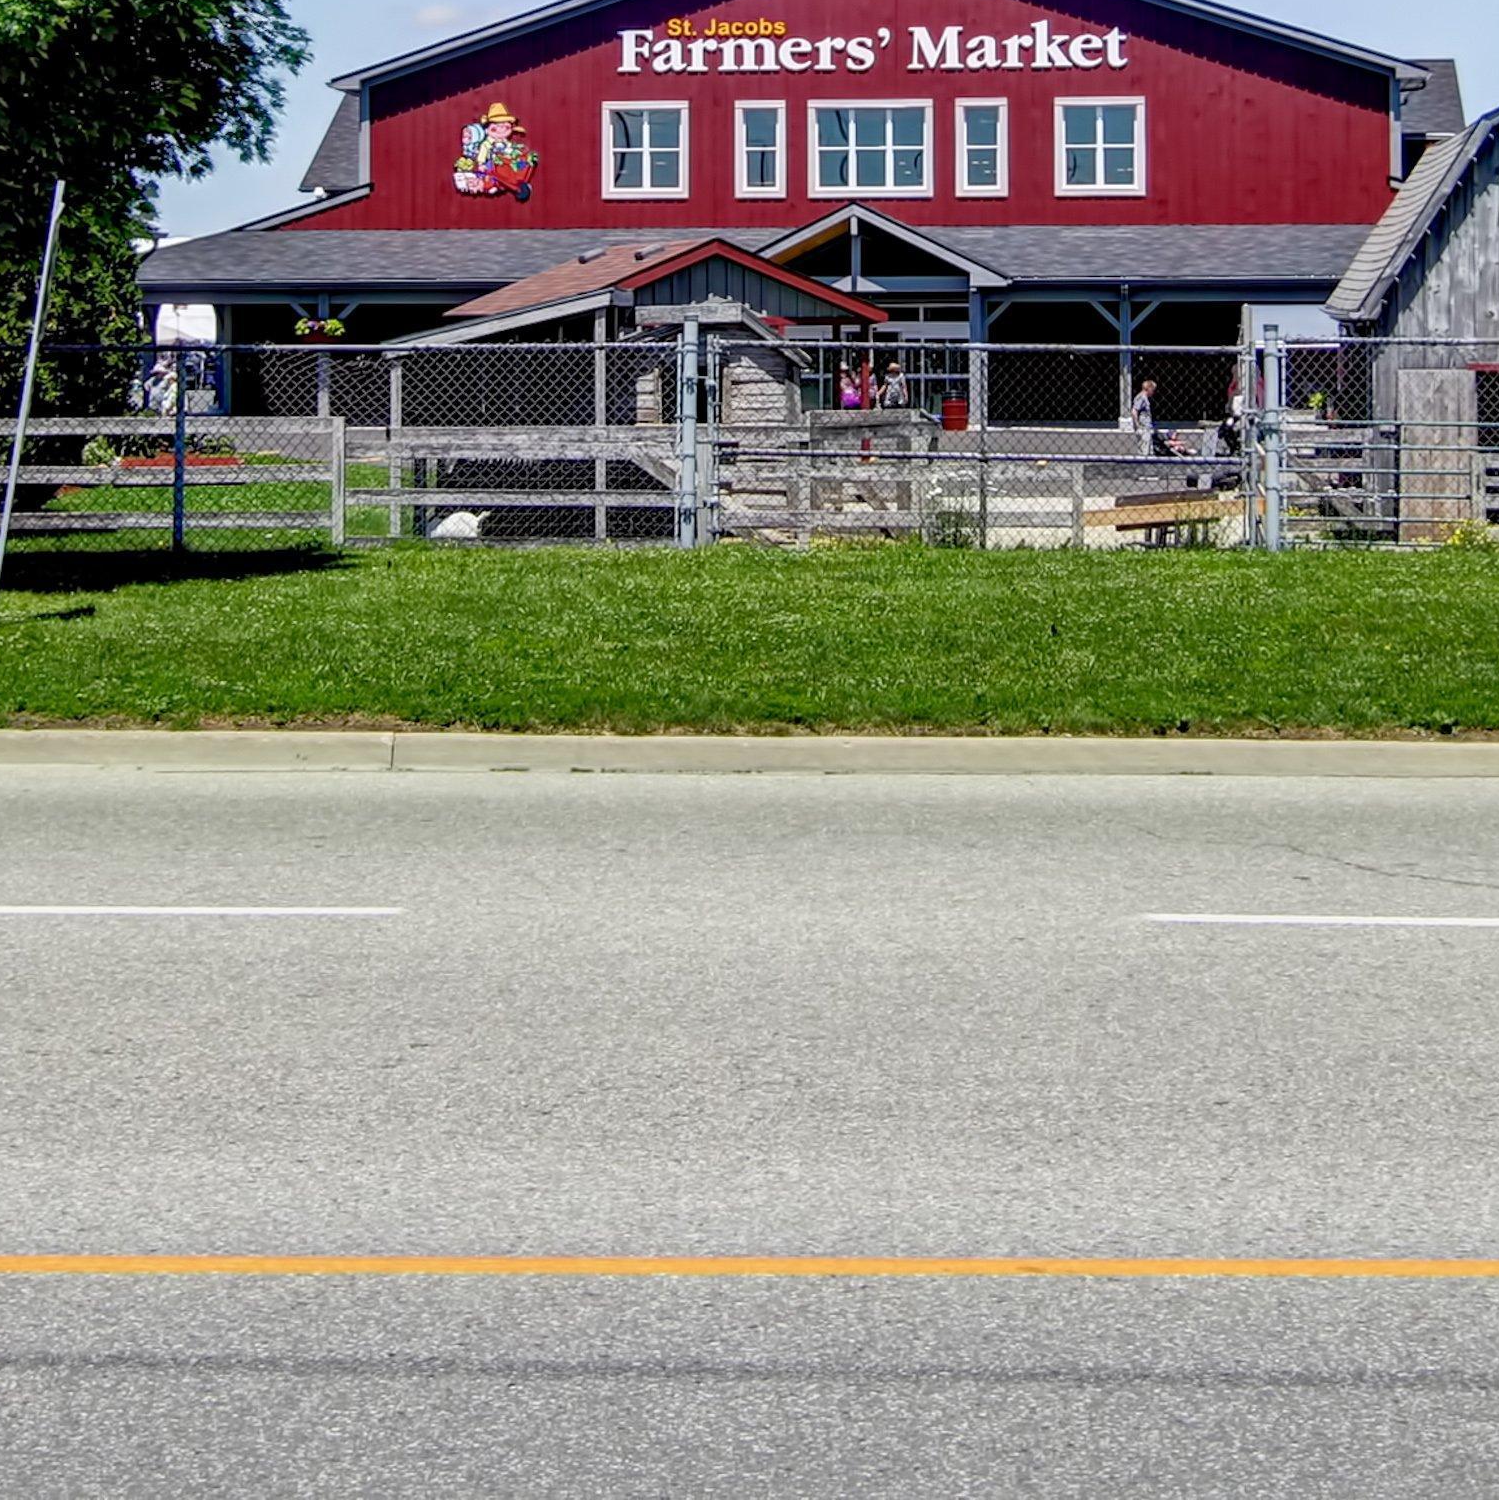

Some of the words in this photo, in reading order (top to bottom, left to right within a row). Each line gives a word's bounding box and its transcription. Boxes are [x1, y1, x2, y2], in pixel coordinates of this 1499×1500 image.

[667, 18, 697, 36] St.
[704, 18, 787, 36] Jacobs
[617, 27, 892, 72] Farmers’
[906, 19, 1129, 69] Market
